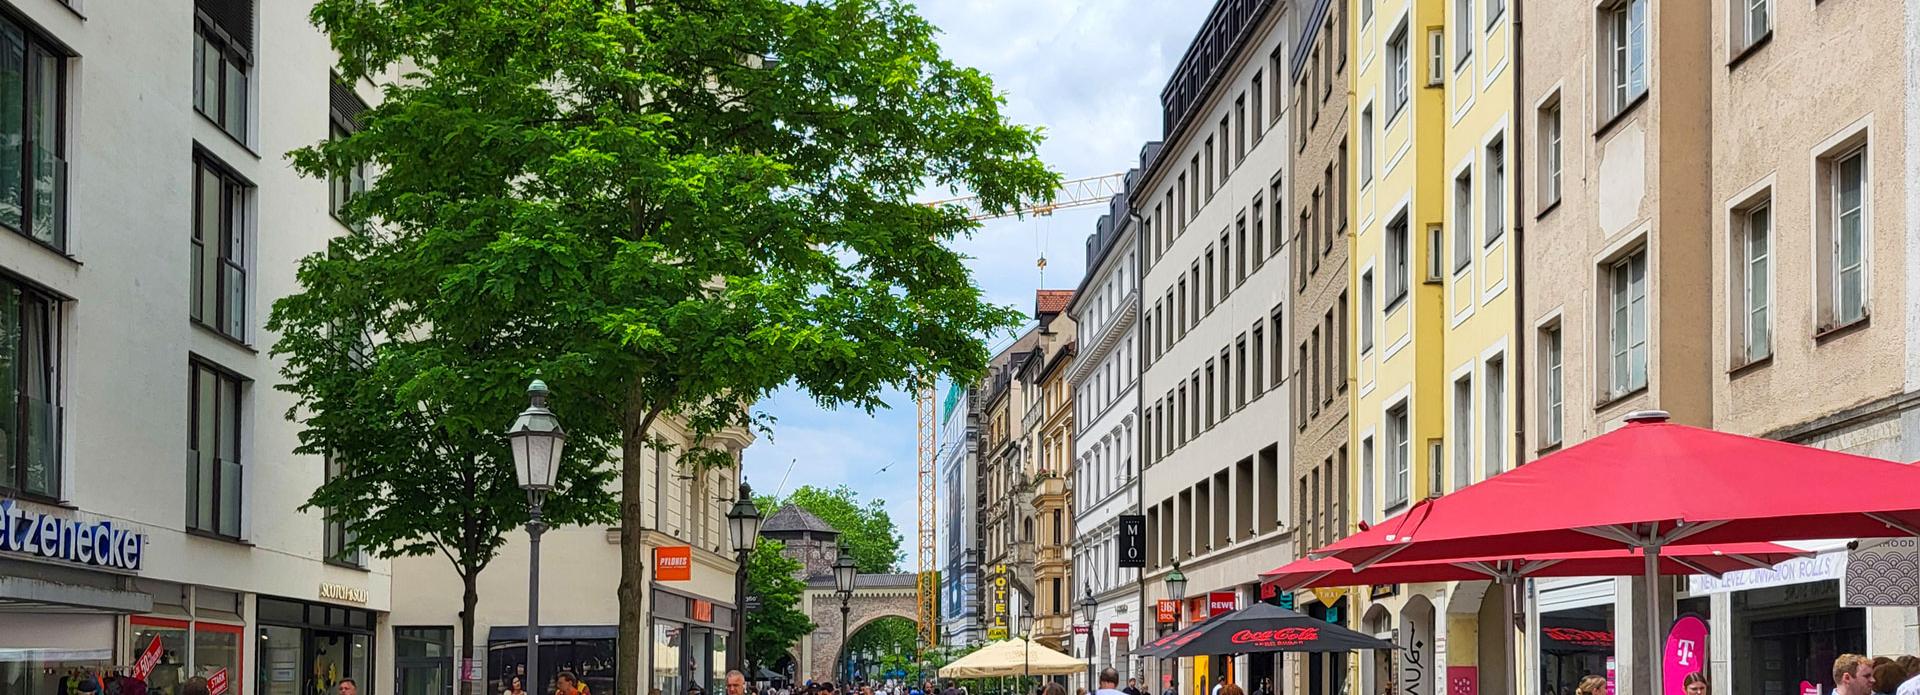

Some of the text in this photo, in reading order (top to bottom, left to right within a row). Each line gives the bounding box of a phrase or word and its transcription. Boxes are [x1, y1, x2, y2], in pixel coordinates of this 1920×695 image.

[1127, 524, 1138, 559] MIO
[1800, 557, 1831, 578] ROLLS
[995, 564, 1007, 626] HOTEL
[1211, 601, 1234, 609] REWE
[1231, 626, 1320, 644] Coca-Cola
